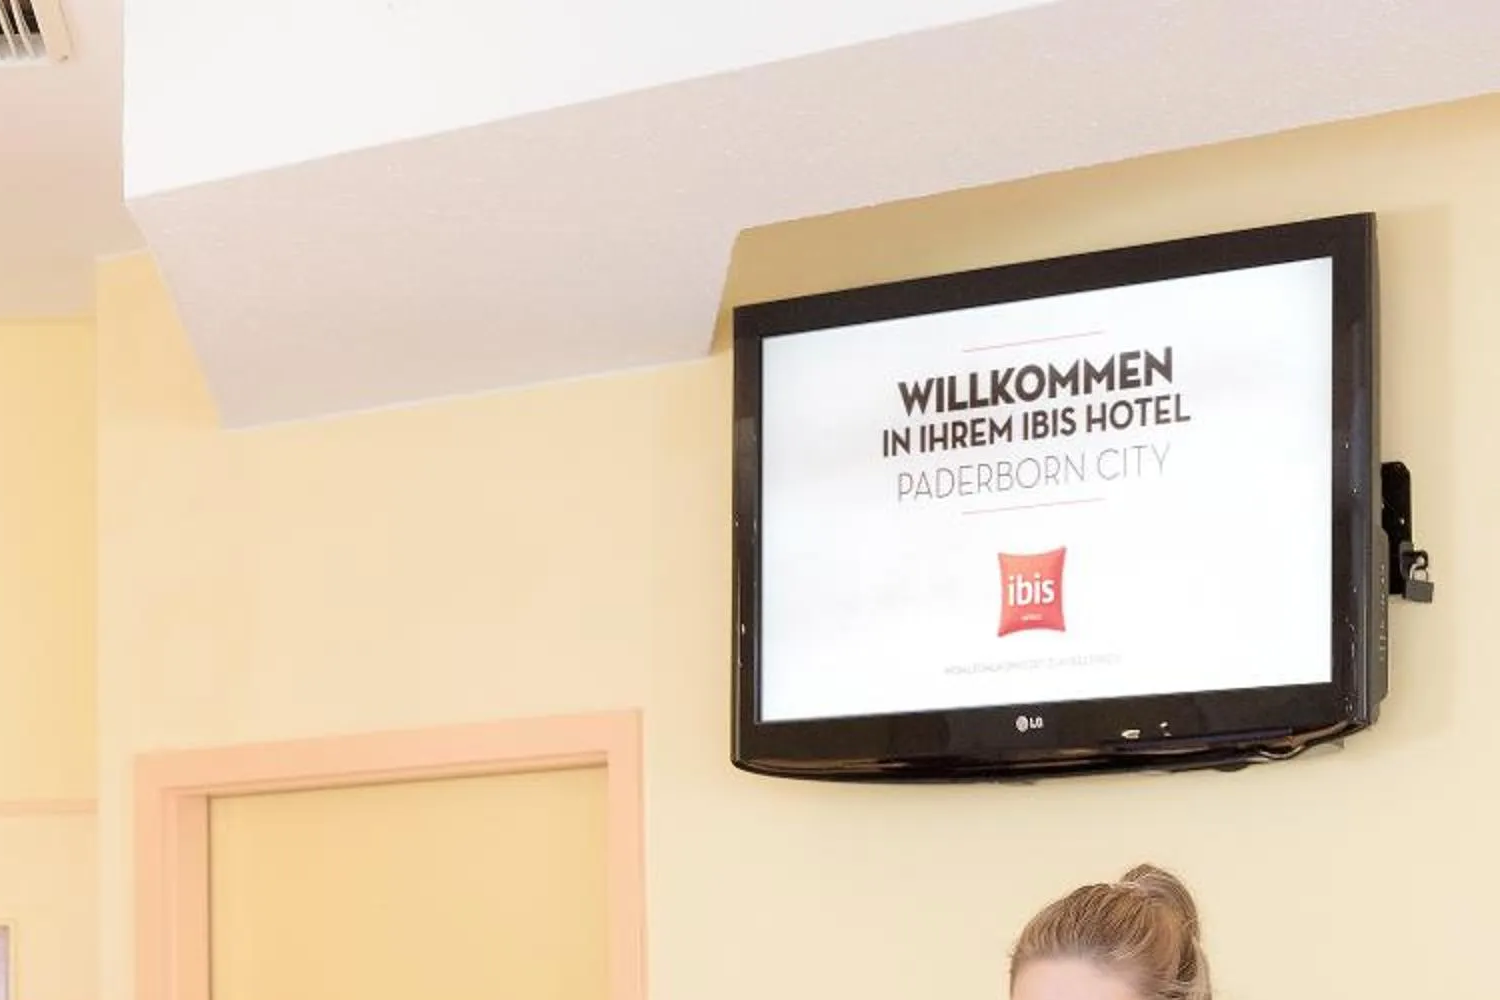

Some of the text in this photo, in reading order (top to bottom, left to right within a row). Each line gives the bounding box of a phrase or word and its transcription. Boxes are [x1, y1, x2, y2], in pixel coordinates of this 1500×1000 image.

[898, 346, 1173, 416] WILLKOMMEN
[883, 393, 1191, 457] IN IHREM IBIS HOTEL
[898, 442, 1171, 502] PADERBORN CITY
[1007, 572, 1056, 607] ibis
